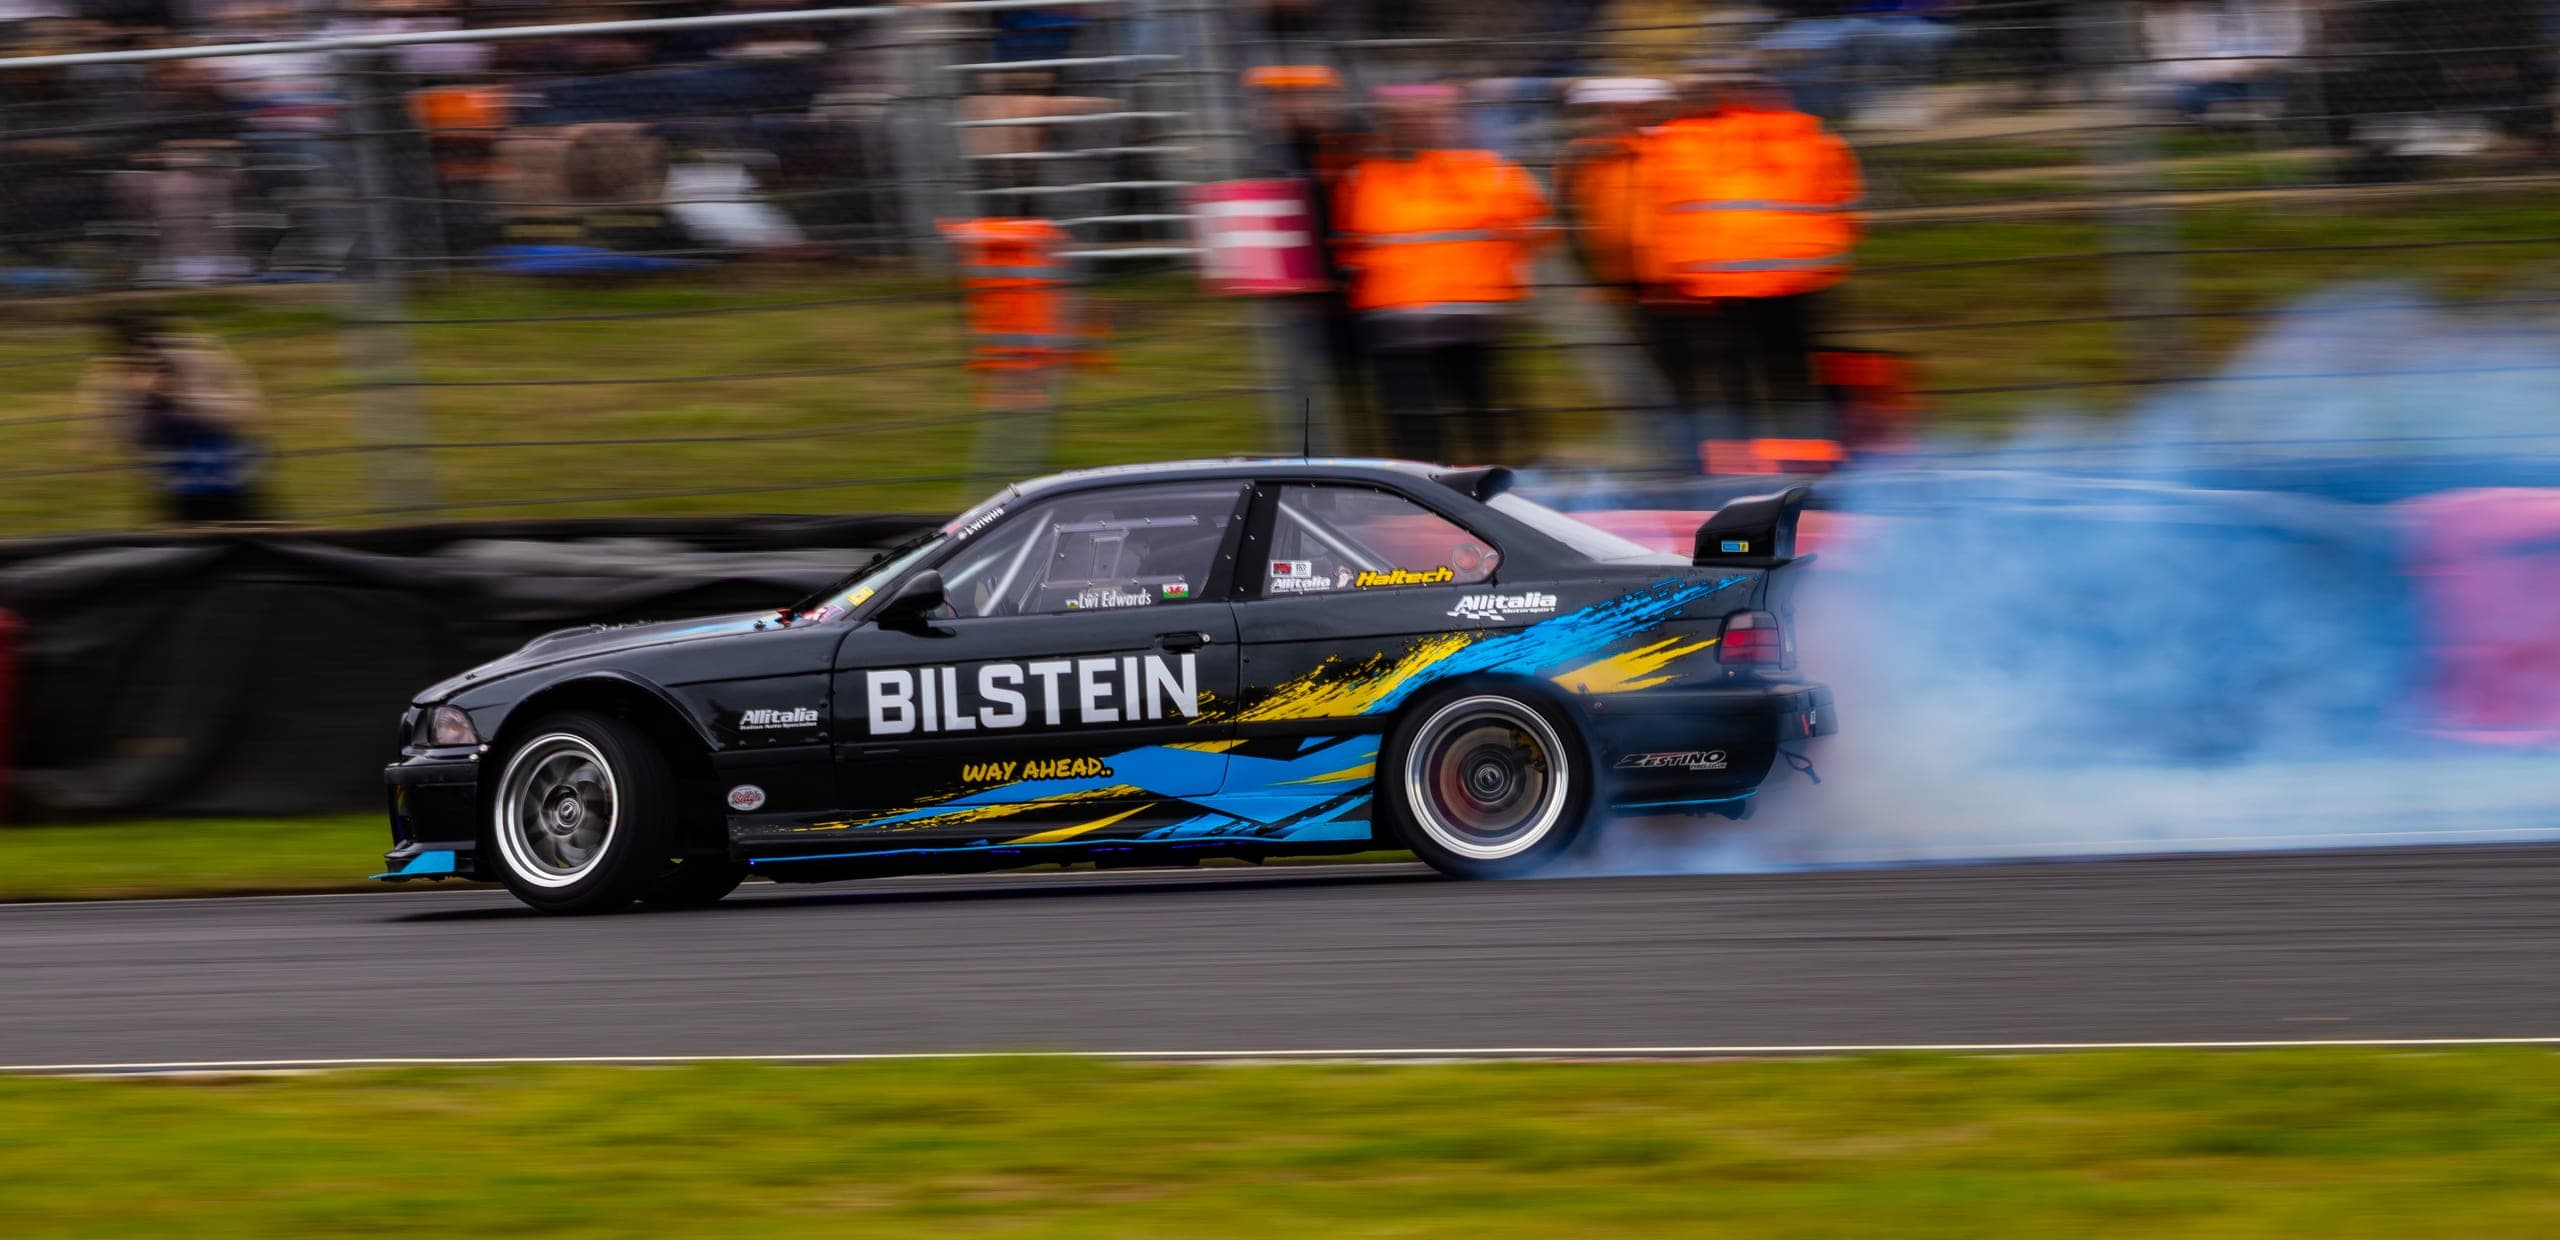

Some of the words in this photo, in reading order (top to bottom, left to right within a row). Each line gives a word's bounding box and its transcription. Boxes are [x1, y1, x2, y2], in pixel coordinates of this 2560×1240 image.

[1355, 566, 1454, 587] Haltech
[1079, 592, 1099, 609] Lwi
[1102, 588, 1152, 608] Edwards
[1455, 592, 1557, 611] Allitalia
[866, 653, 1199, 735] BILSTEIN
[740, 708, 818, 725] Allitalia
[962, 761, 1017, 783] WAY
[1022, 757, 1112, 779] AHEAD..
